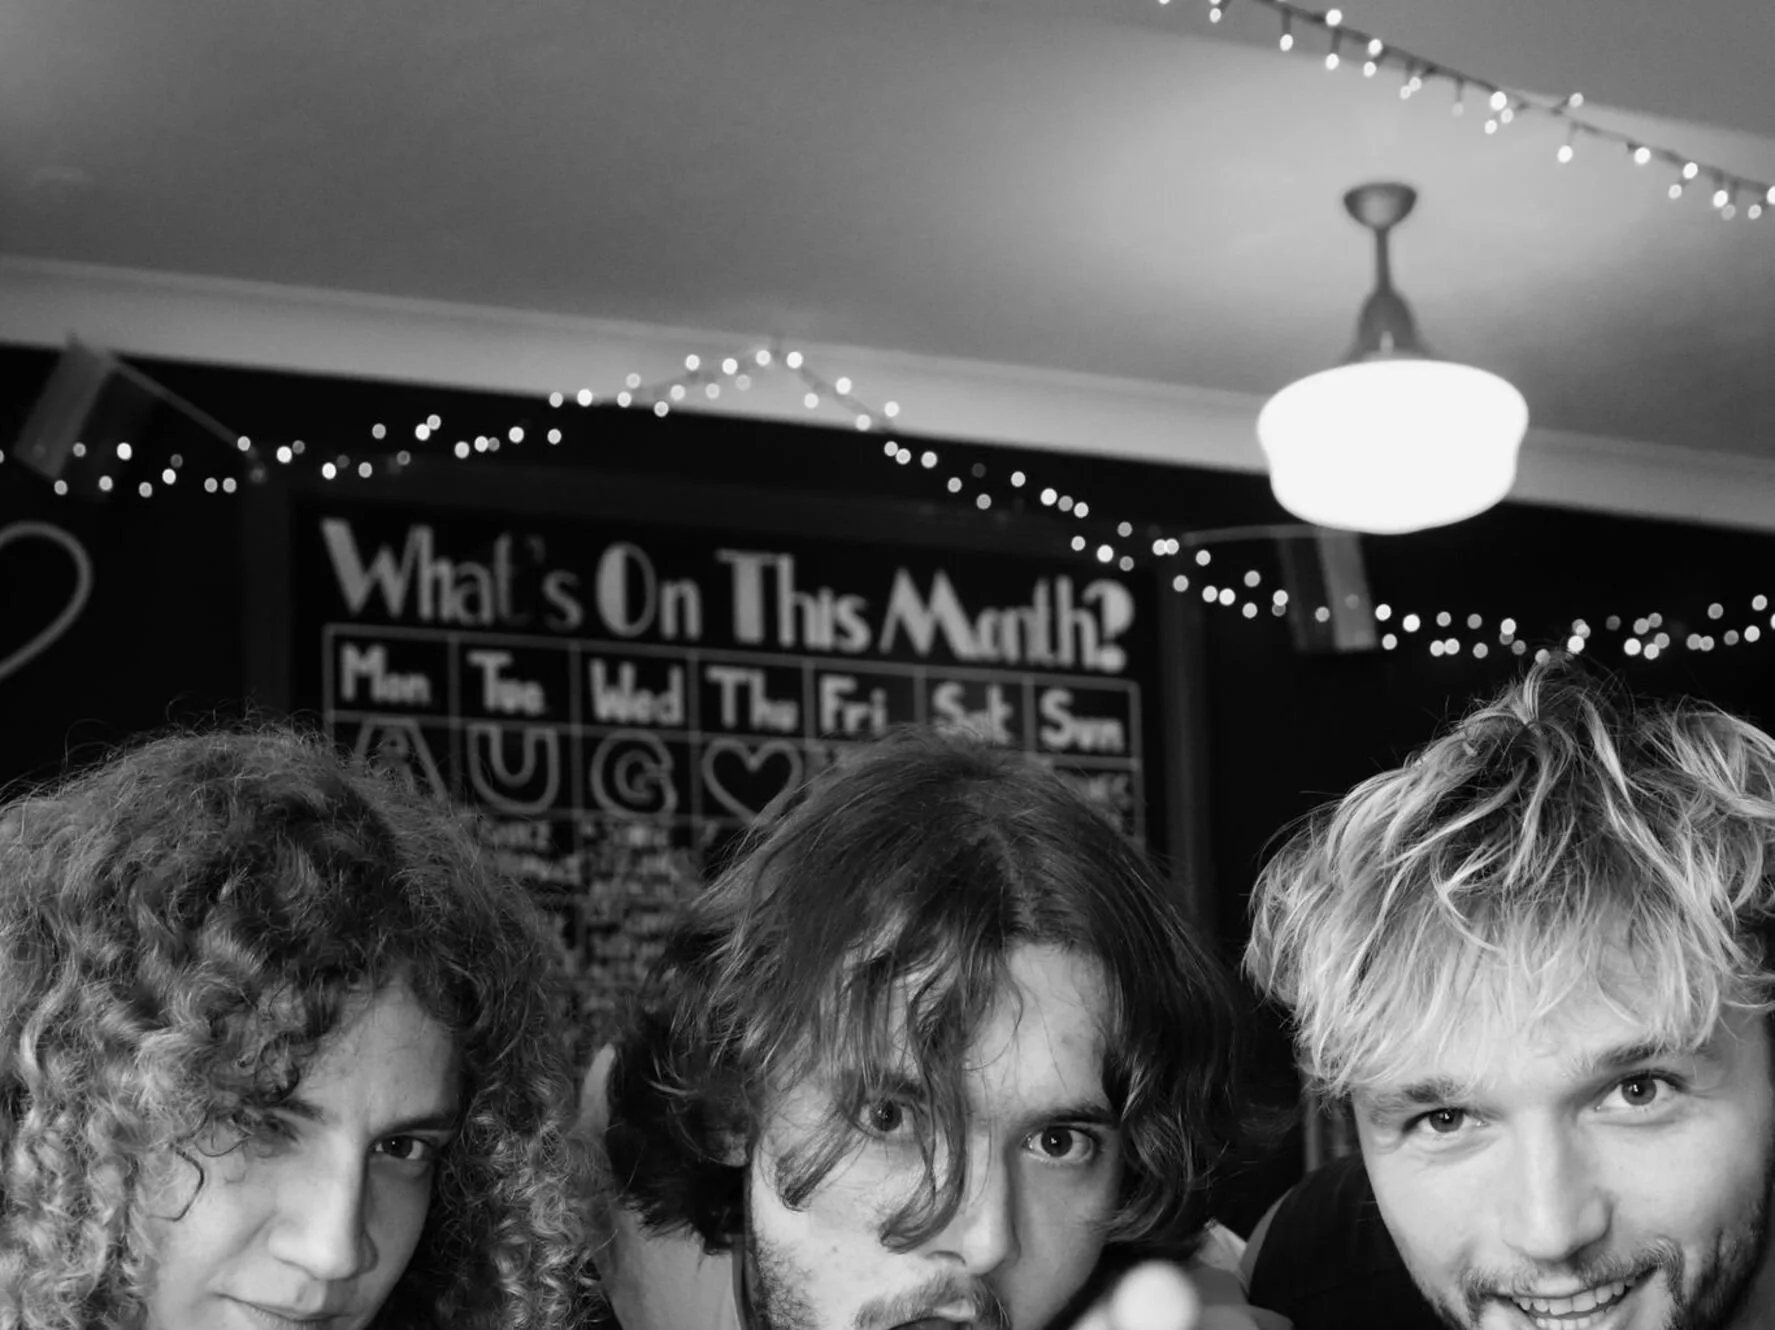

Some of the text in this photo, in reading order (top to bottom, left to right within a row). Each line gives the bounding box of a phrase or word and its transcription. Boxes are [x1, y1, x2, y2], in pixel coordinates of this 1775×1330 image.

[320, 516, 1136, 674] What's On This Month?
[339, 640, 432, 703] Mon
[465, 648, 546, 715] Tue
[588, 656, 685, 726] Wed
[704, 664, 799, 733] Thu
[817, 673, 888, 737] Fri
[1039, 687, 1126, 752] Sun
